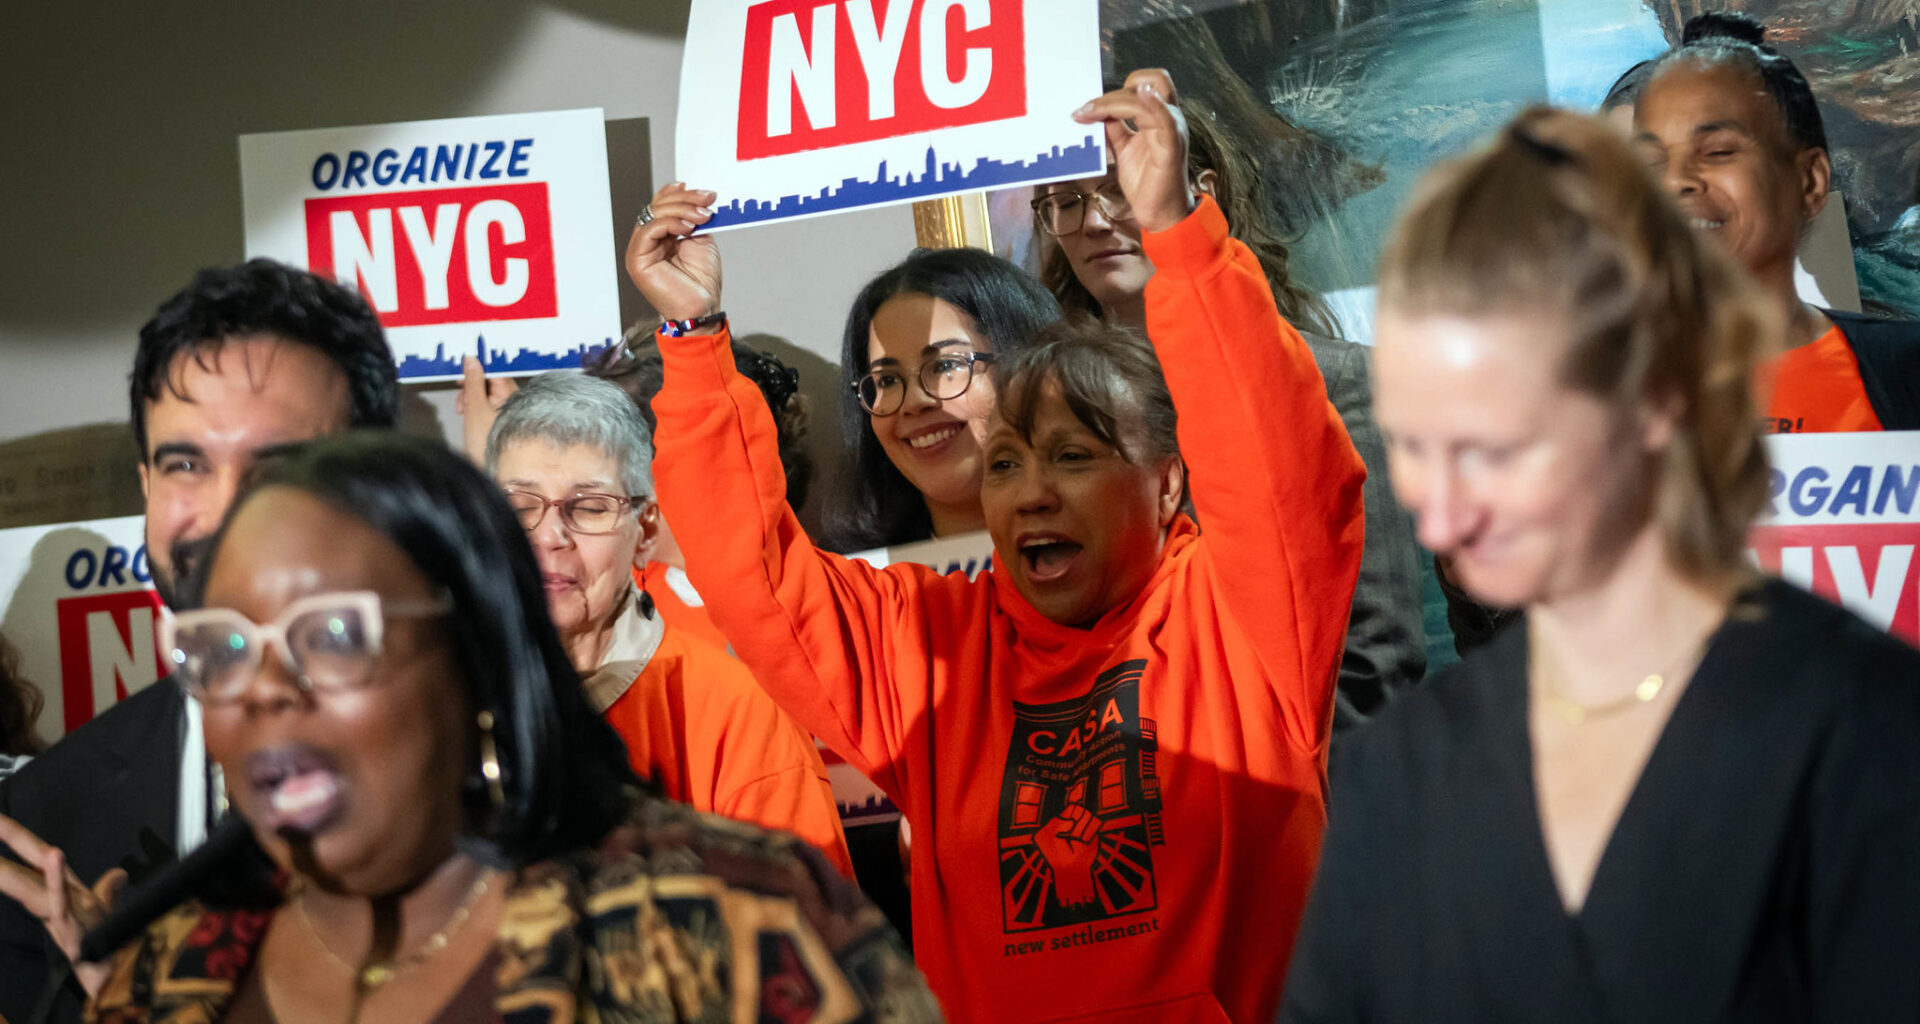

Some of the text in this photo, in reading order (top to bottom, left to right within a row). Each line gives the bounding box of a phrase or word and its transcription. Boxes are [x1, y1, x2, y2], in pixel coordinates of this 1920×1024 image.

[766, 0, 993, 138] NYC
[312, 138, 534, 191] ORGANIZE
[330, 199, 530, 313] NYC
[1027, 698, 1124, 757] CASA
[1018, 764, 1037, 777] for
[1040, 769, 1070, 782] Safe
[1004, 917, 1160, 957] new settlement
